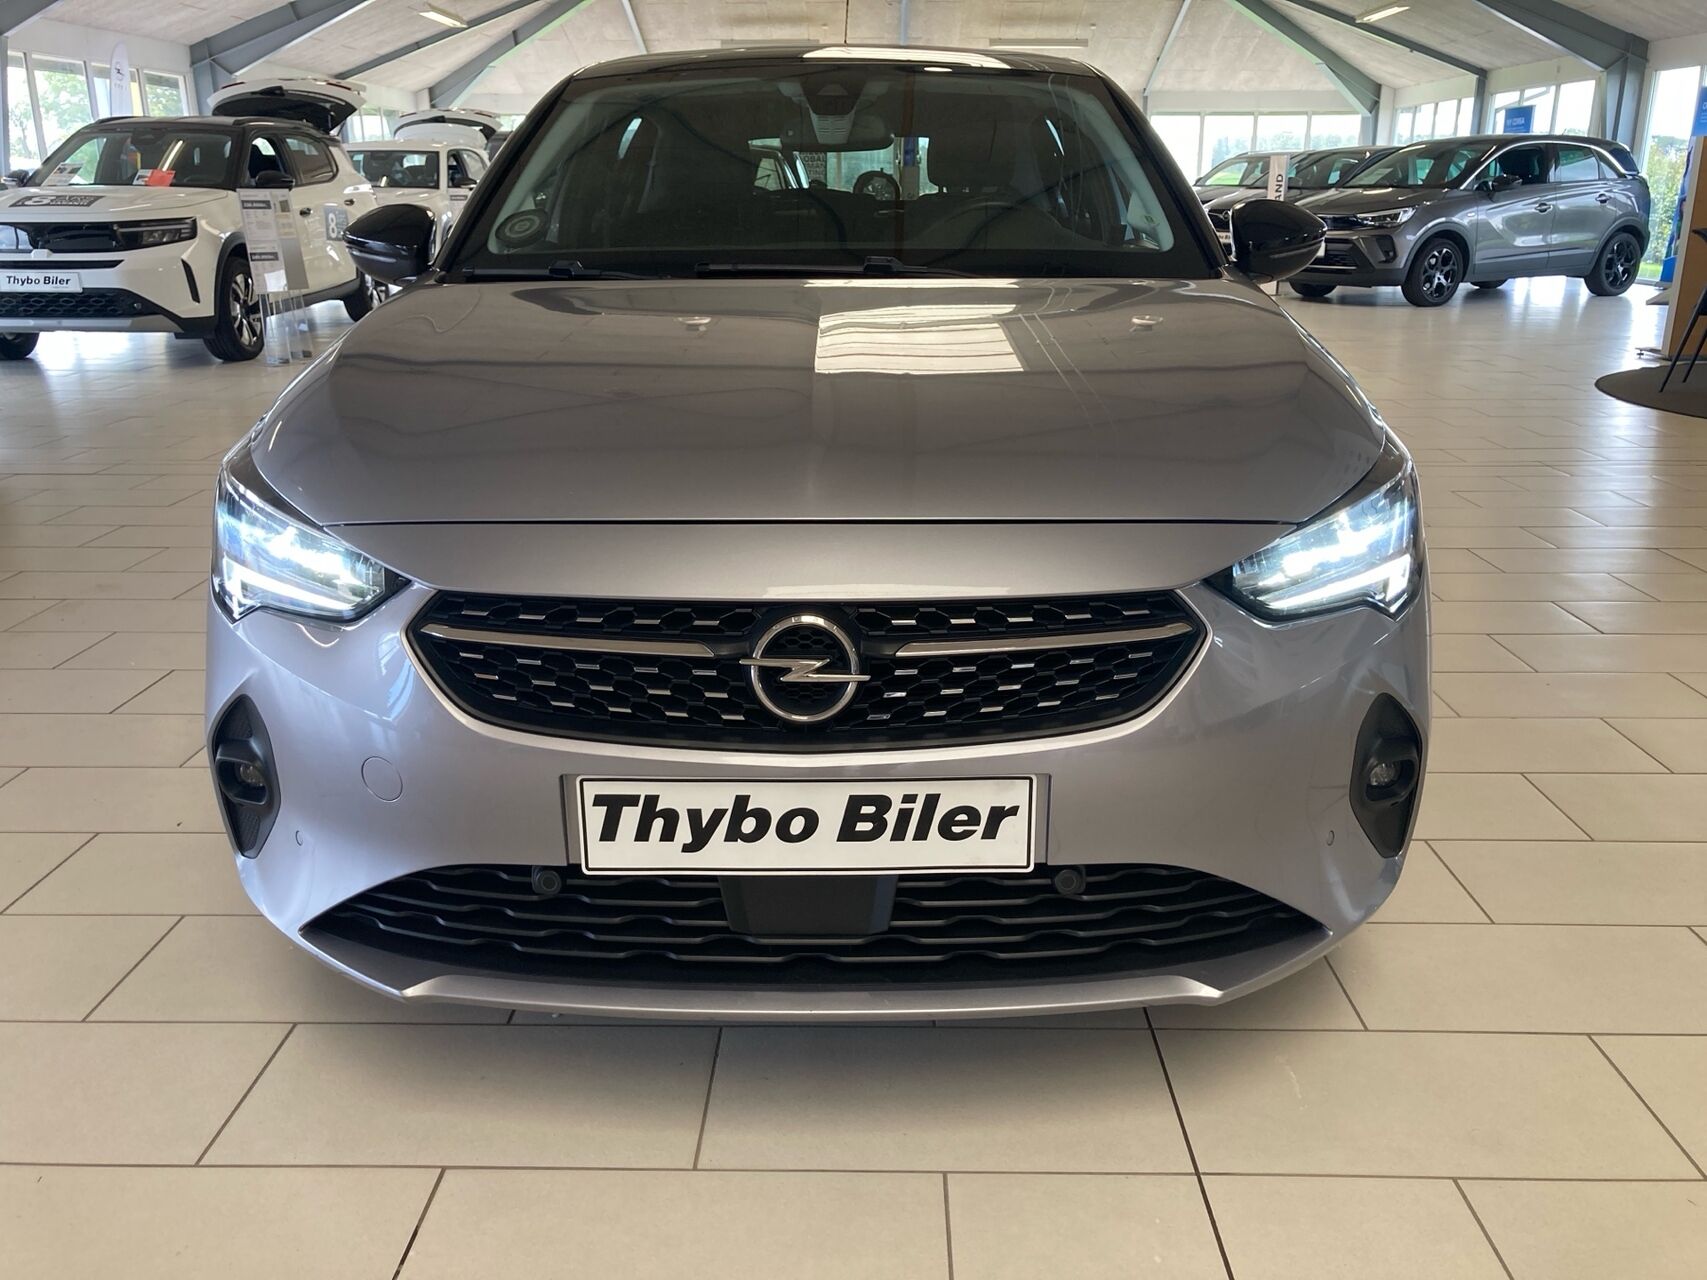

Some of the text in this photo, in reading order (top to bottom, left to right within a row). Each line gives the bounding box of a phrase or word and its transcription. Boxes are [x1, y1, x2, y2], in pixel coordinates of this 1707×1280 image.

[6, 275, 71, 286] Thybo Biler
[592, 793, 1020, 852] Thybo Biler
